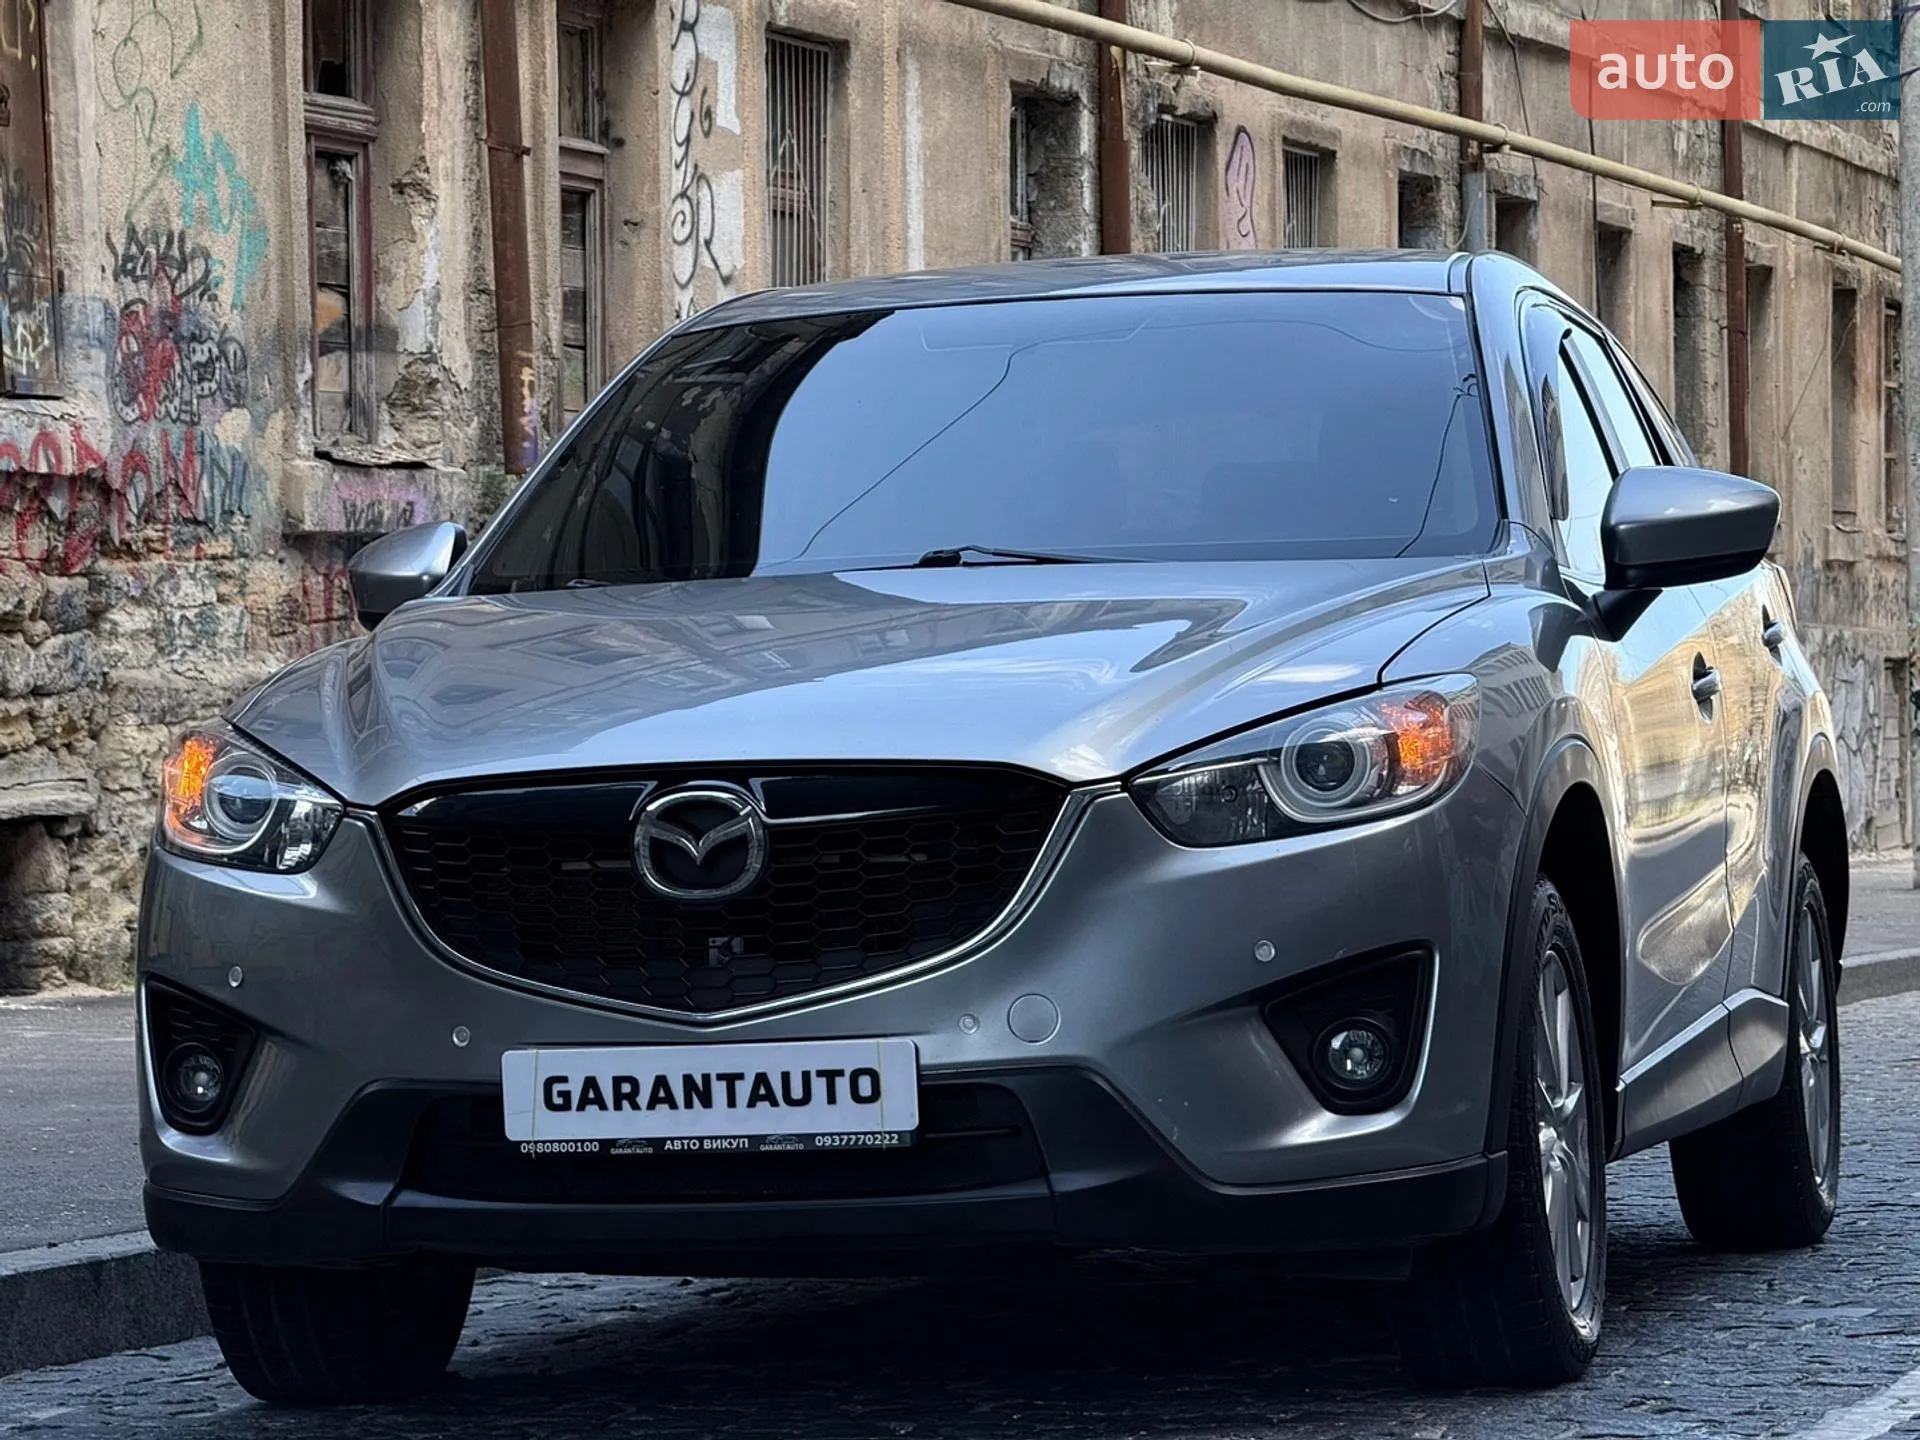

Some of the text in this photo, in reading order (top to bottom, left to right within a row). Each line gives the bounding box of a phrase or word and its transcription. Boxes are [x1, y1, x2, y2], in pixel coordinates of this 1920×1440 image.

[543, 1067, 881, 1112] GARANTAUTO
[664, 1138, 748, 1151] АВТО ВИКУП
[815, 1133, 899, 1147] 0937770222
[520, 1141, 599, 1153] 0980800100
